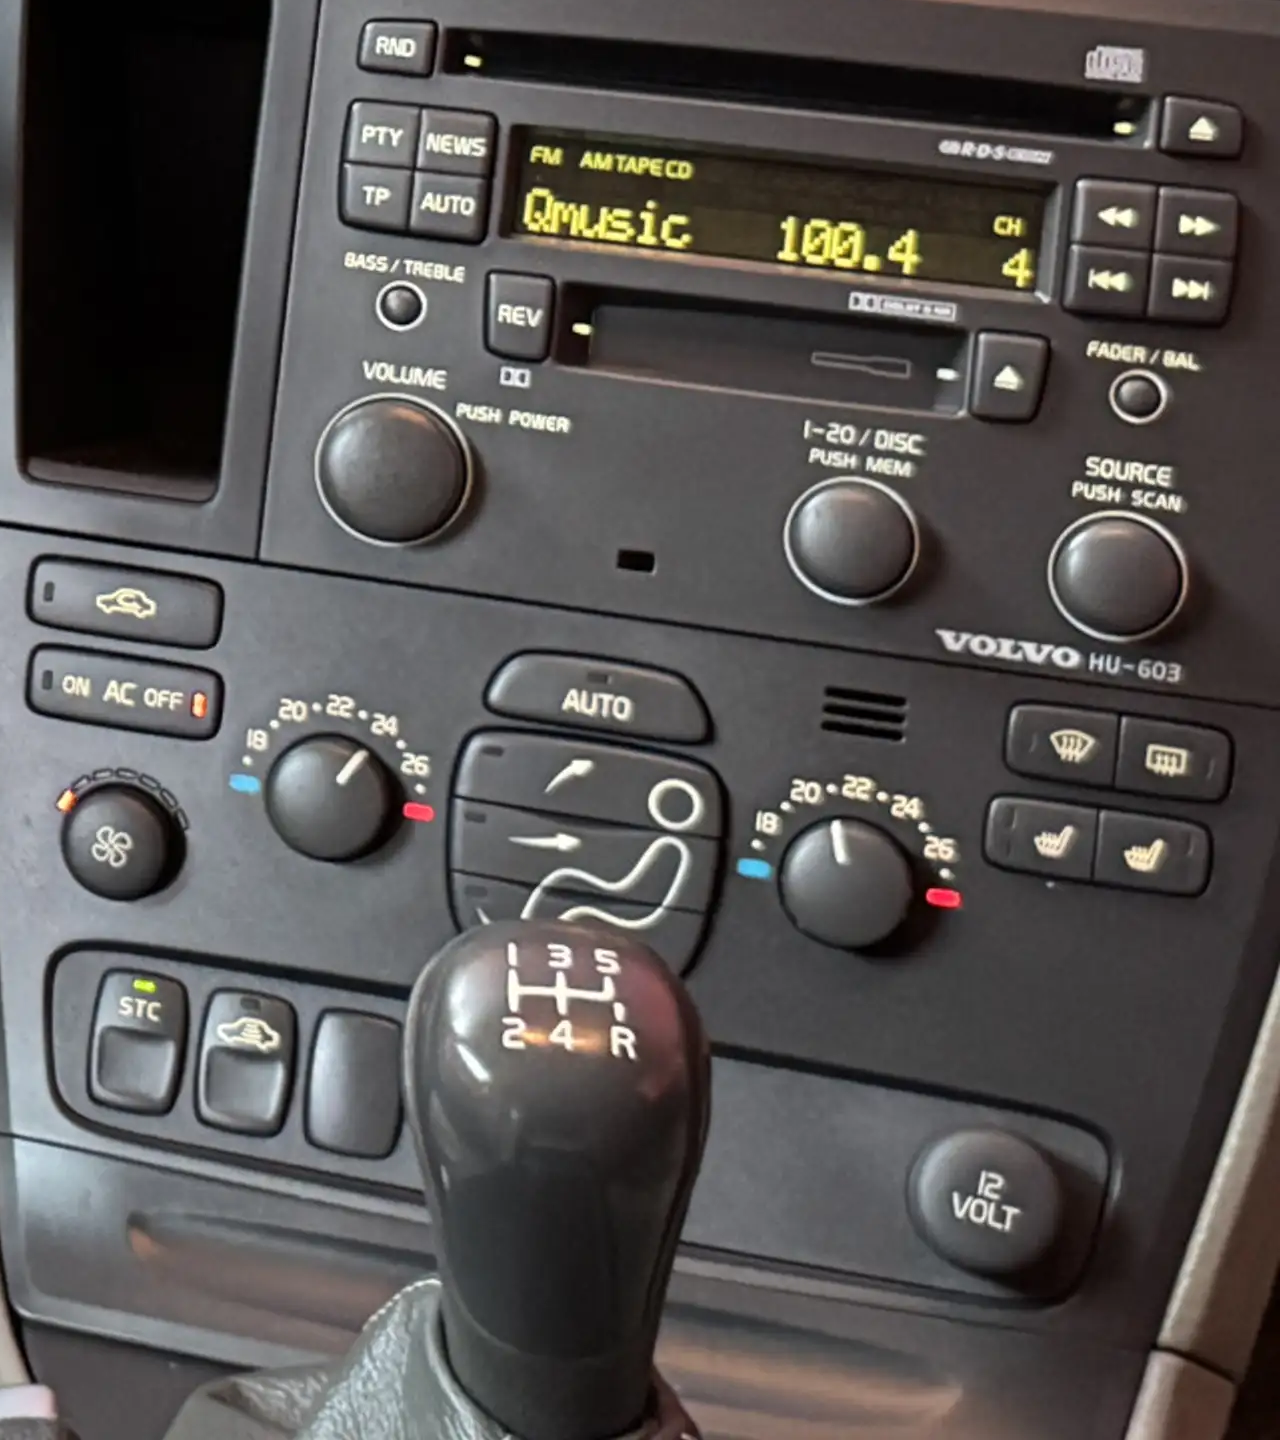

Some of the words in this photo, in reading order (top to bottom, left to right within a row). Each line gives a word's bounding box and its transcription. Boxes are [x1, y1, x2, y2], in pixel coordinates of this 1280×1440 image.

[375, 35, 416, 59] RND
[362, 124, 404, 149] PTY
[425, 133, 487, 158] NEWS
[530, 145, 564, 166] FM
[579, 150, 613, 171] AM
[615, 153, 665, 178] TAPE
[665, 159, 694, 181] CD
[363, 185, 392, 208] TP
[420, 191, 476, 218] AUTO
[522, 186, 693, 250] Qmusic
[776, 215, 923, 276] 100.4
[1001, 247, 1035, 289] 4
[993, 215, 1026, 238] CH
[343, 251, 389, 273] BASS
[402, 258, 466, 284] TREBLE
[497, 303, 543, 329] REV
[1086, 340, 1147, 364] FADER
[1162, 350, 1203, 372] BAL
[363, 360, 448, 391] VOLUME
[456, 402, 502, 425] PUSH
[508, 409, 572, 434] POWER
[803, 419, 857, 446] 1-20
[873, 428, 928, 457] DISC
[808, 447, 858, 470] PUSH
[865, 455, 917, 478] MEM
[1085, 456, 1174, 487] SOURCE
[1071, 481, 1121, 504] PUSH
[1130, 488, 1187, 514] SCAN
[935, 629, 1082, 669] VOLVO
[1088, 653, 1183, 683] HU-603
[61, 674, 91, 698] ON
[102, 679, 139, 708] AC
[143, 687, 184, 711] OFF
[562, 687, 635, 721] AUTO
[247, 728, 268, 751] 18
[278, 698, 308, 723] 20
[325, 694, 356, 717] 22
[370, 713, 399, 737] 24
[400, 752, 431, 777] 26
[755, 810, 781, 836] 18
[790, 780, 824, 804] 20
[842, 774, 875, 799] 22
[889, 795, 923, 820] 24
[923, 837, 957, 861] 26
[507, 941, 518, 967] 1
[547, 942, 573, 969] 3
[594, 947, 622, 975] 5
[118, 995, 162, 1023] STC
[501, 1017, 527, 1050] 2
[548, 1019, 574, 1051] 4
[610, 1025, 638, 1060] R
[976, 1169, 1007, 1200] 12
[951, 1191, 1022, 1233] VOLT
